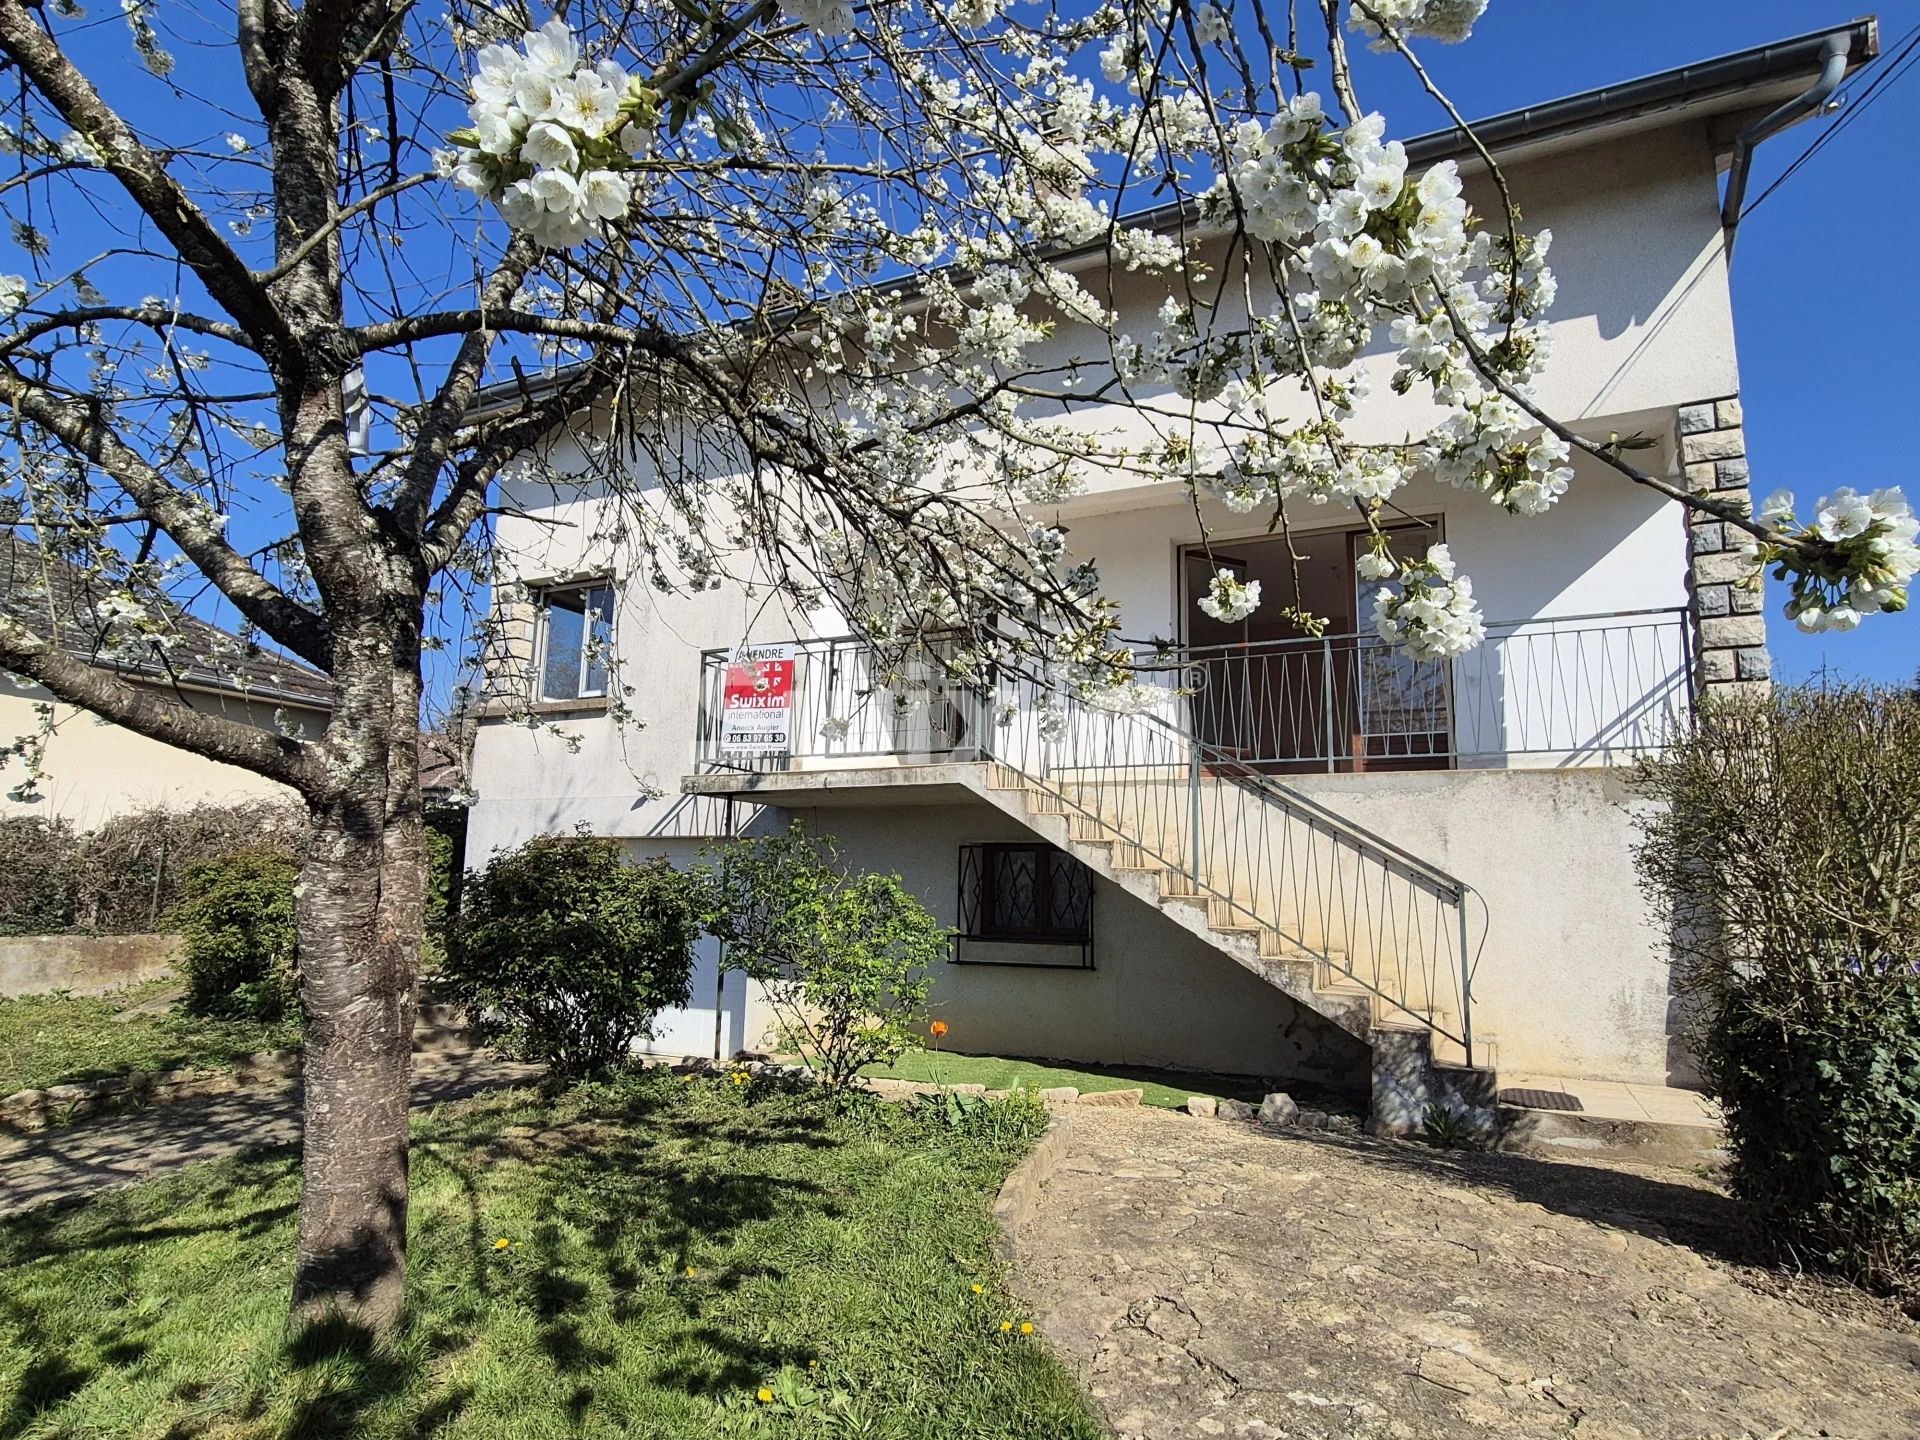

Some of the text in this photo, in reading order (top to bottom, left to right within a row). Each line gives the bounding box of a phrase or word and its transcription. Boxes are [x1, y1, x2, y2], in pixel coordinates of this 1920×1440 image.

[729, 693, 785, 708] Swixim
[728, 709, 784, 719] international
[732, 734, 741, 742] 06
[742, 734, 752, 742] 83
[753, 734, 762, 742] 97
[774, 734, 784, 742] 38
